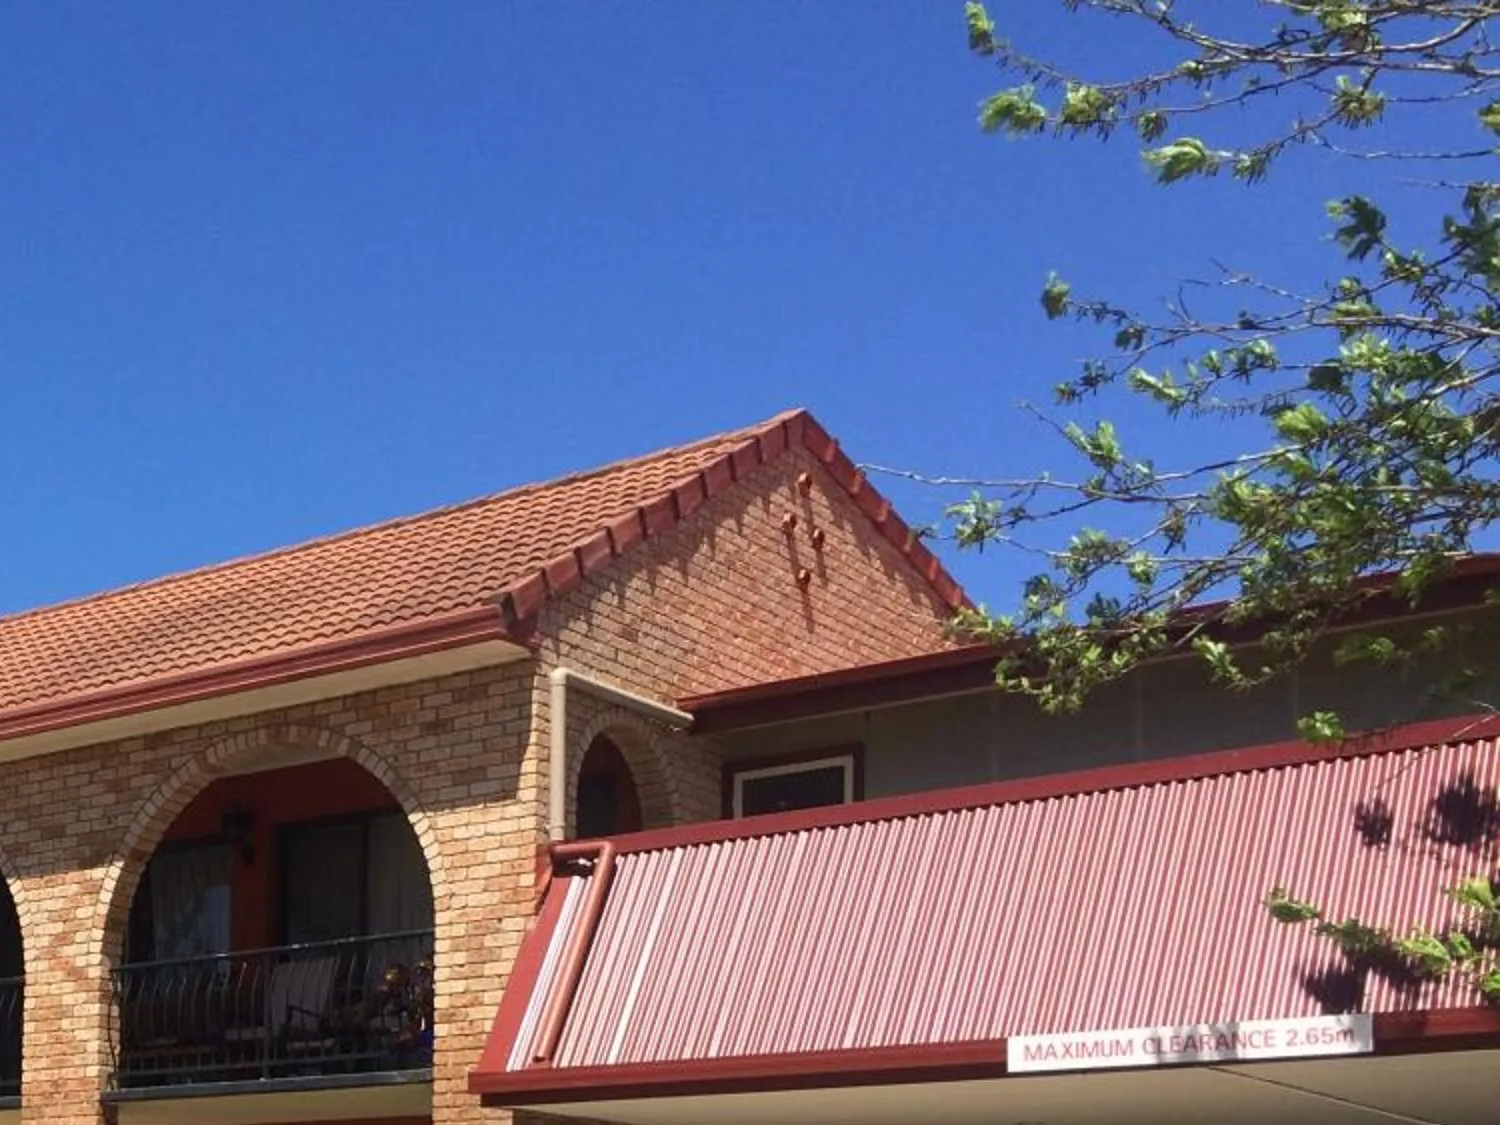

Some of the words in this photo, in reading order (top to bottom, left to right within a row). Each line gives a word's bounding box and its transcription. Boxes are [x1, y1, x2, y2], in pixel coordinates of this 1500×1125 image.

[1023, 1039, 1134, 1062] MAXIMUM
[1141, 1030, 1276, 1054] CLEARANCE
[1285, 1027, 1356, 1048] 2.65m
